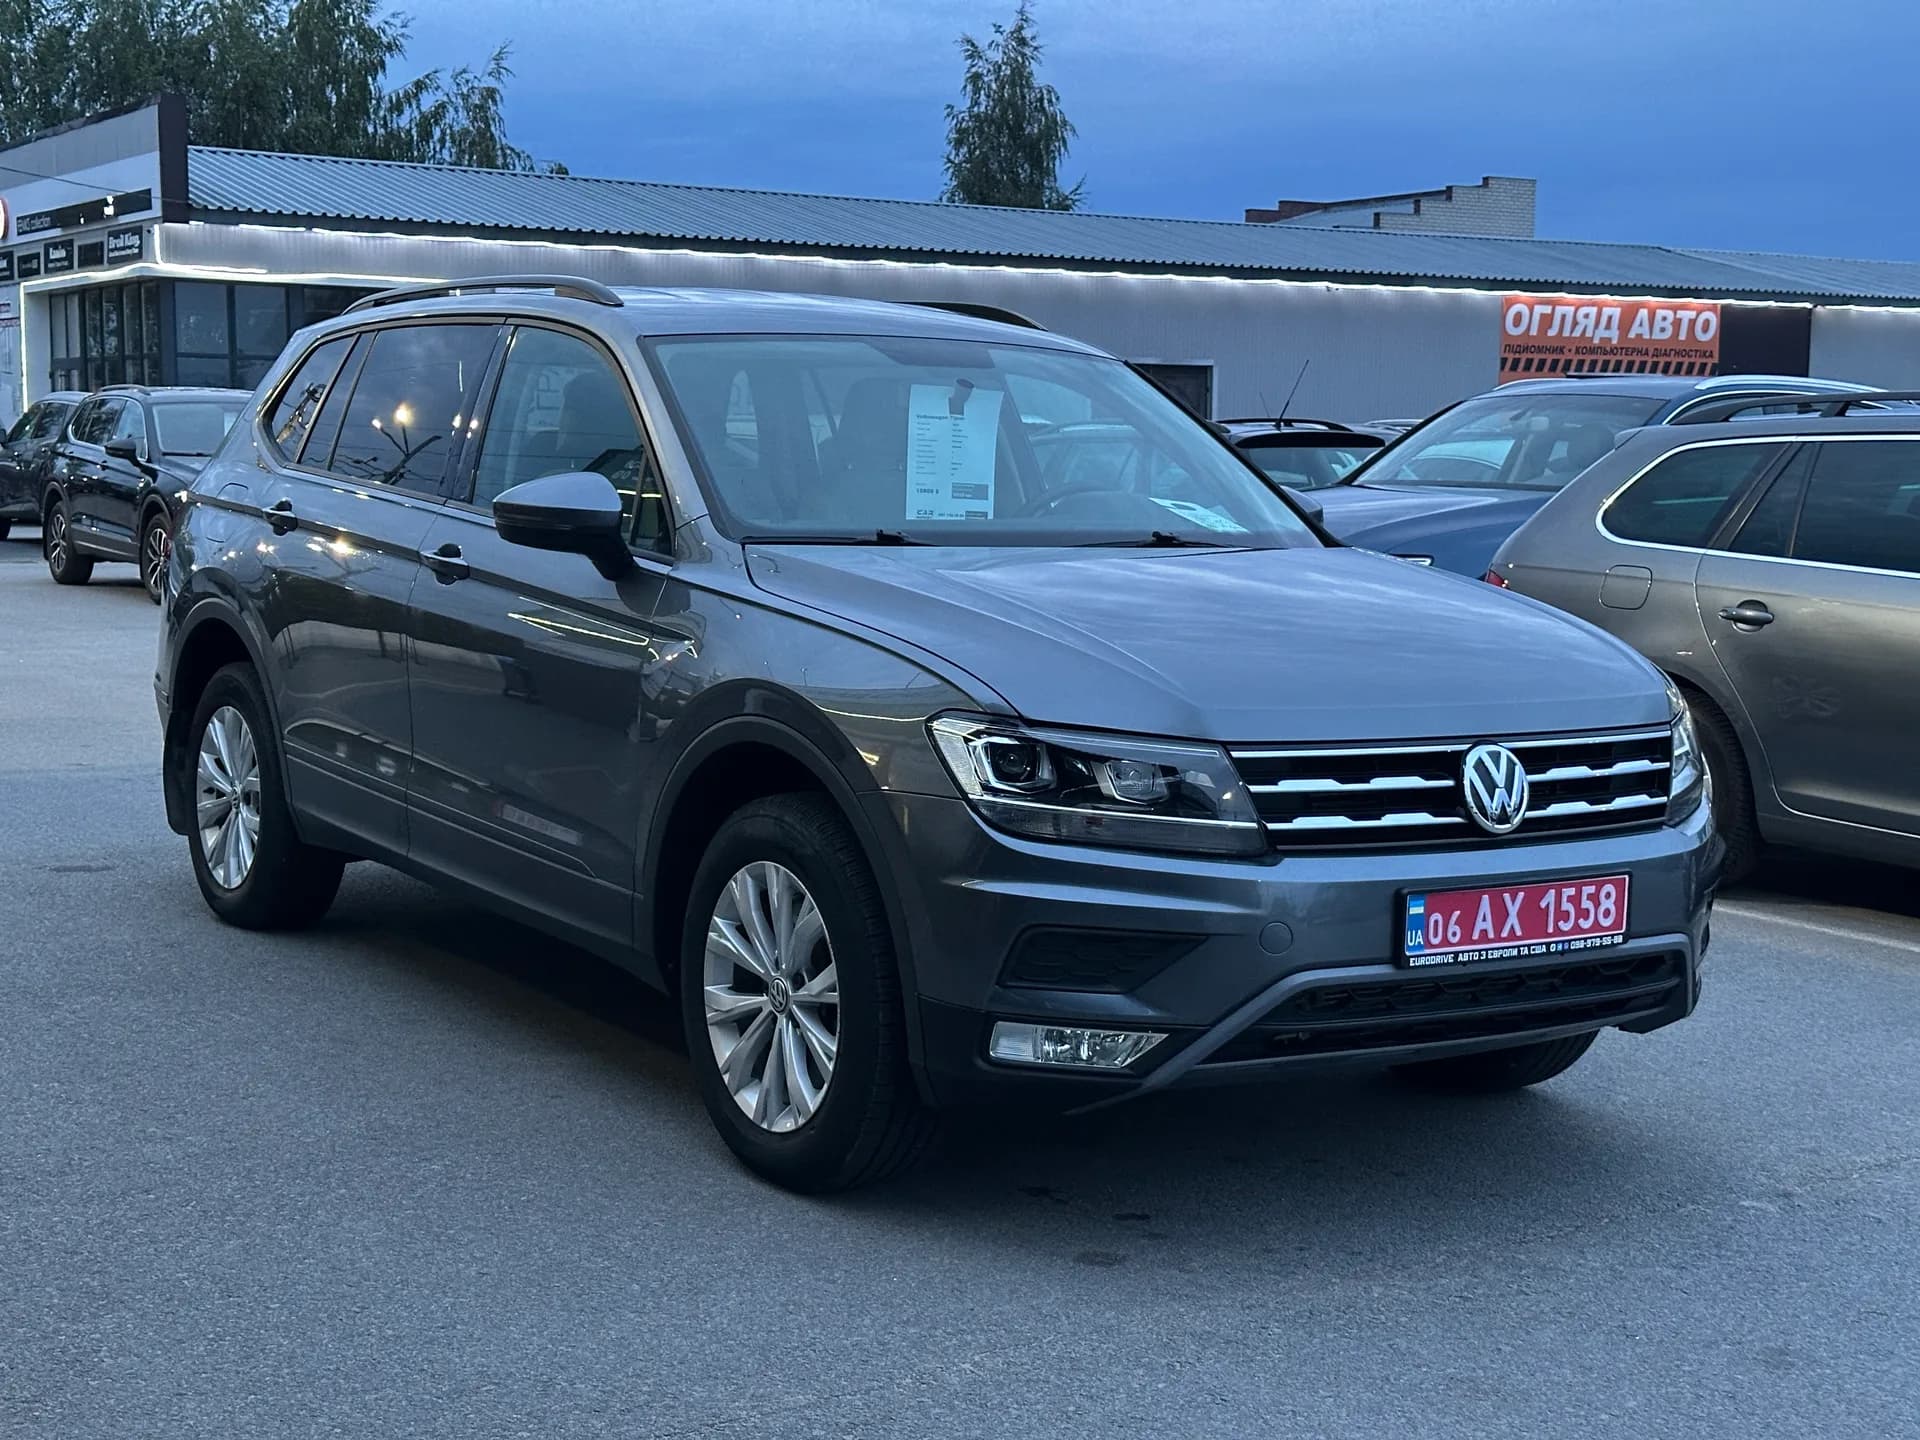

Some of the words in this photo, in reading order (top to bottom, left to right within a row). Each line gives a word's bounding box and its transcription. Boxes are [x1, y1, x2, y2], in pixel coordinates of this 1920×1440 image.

[1505, 303, 1621, 344] ОГЛЯД
[1627, 307, 1718, 342] АВТО
[1503, 343, 1566, 356] ПІДЙОМНИК
[1574, 345, 1650, 357] КОМПЬЮТЕРНА
[1651, 348, 1715, 360] ДІАГНОСТІКА
[1464, 744, 1529, 833] VW
[1427, 910, 1462, 946] 06
[1471, 892, 1525, 940] AX
[1539, 883, 1617, 934] 1558
[1407, 930, 1424, 946] UA
[1409, 953, 1455, 967] EURODRIVE
[1457, 950, 1480, 962] АВТО
[1519, 946, 1530, 956] ТА
[1530, 944, 1547, 955] США
